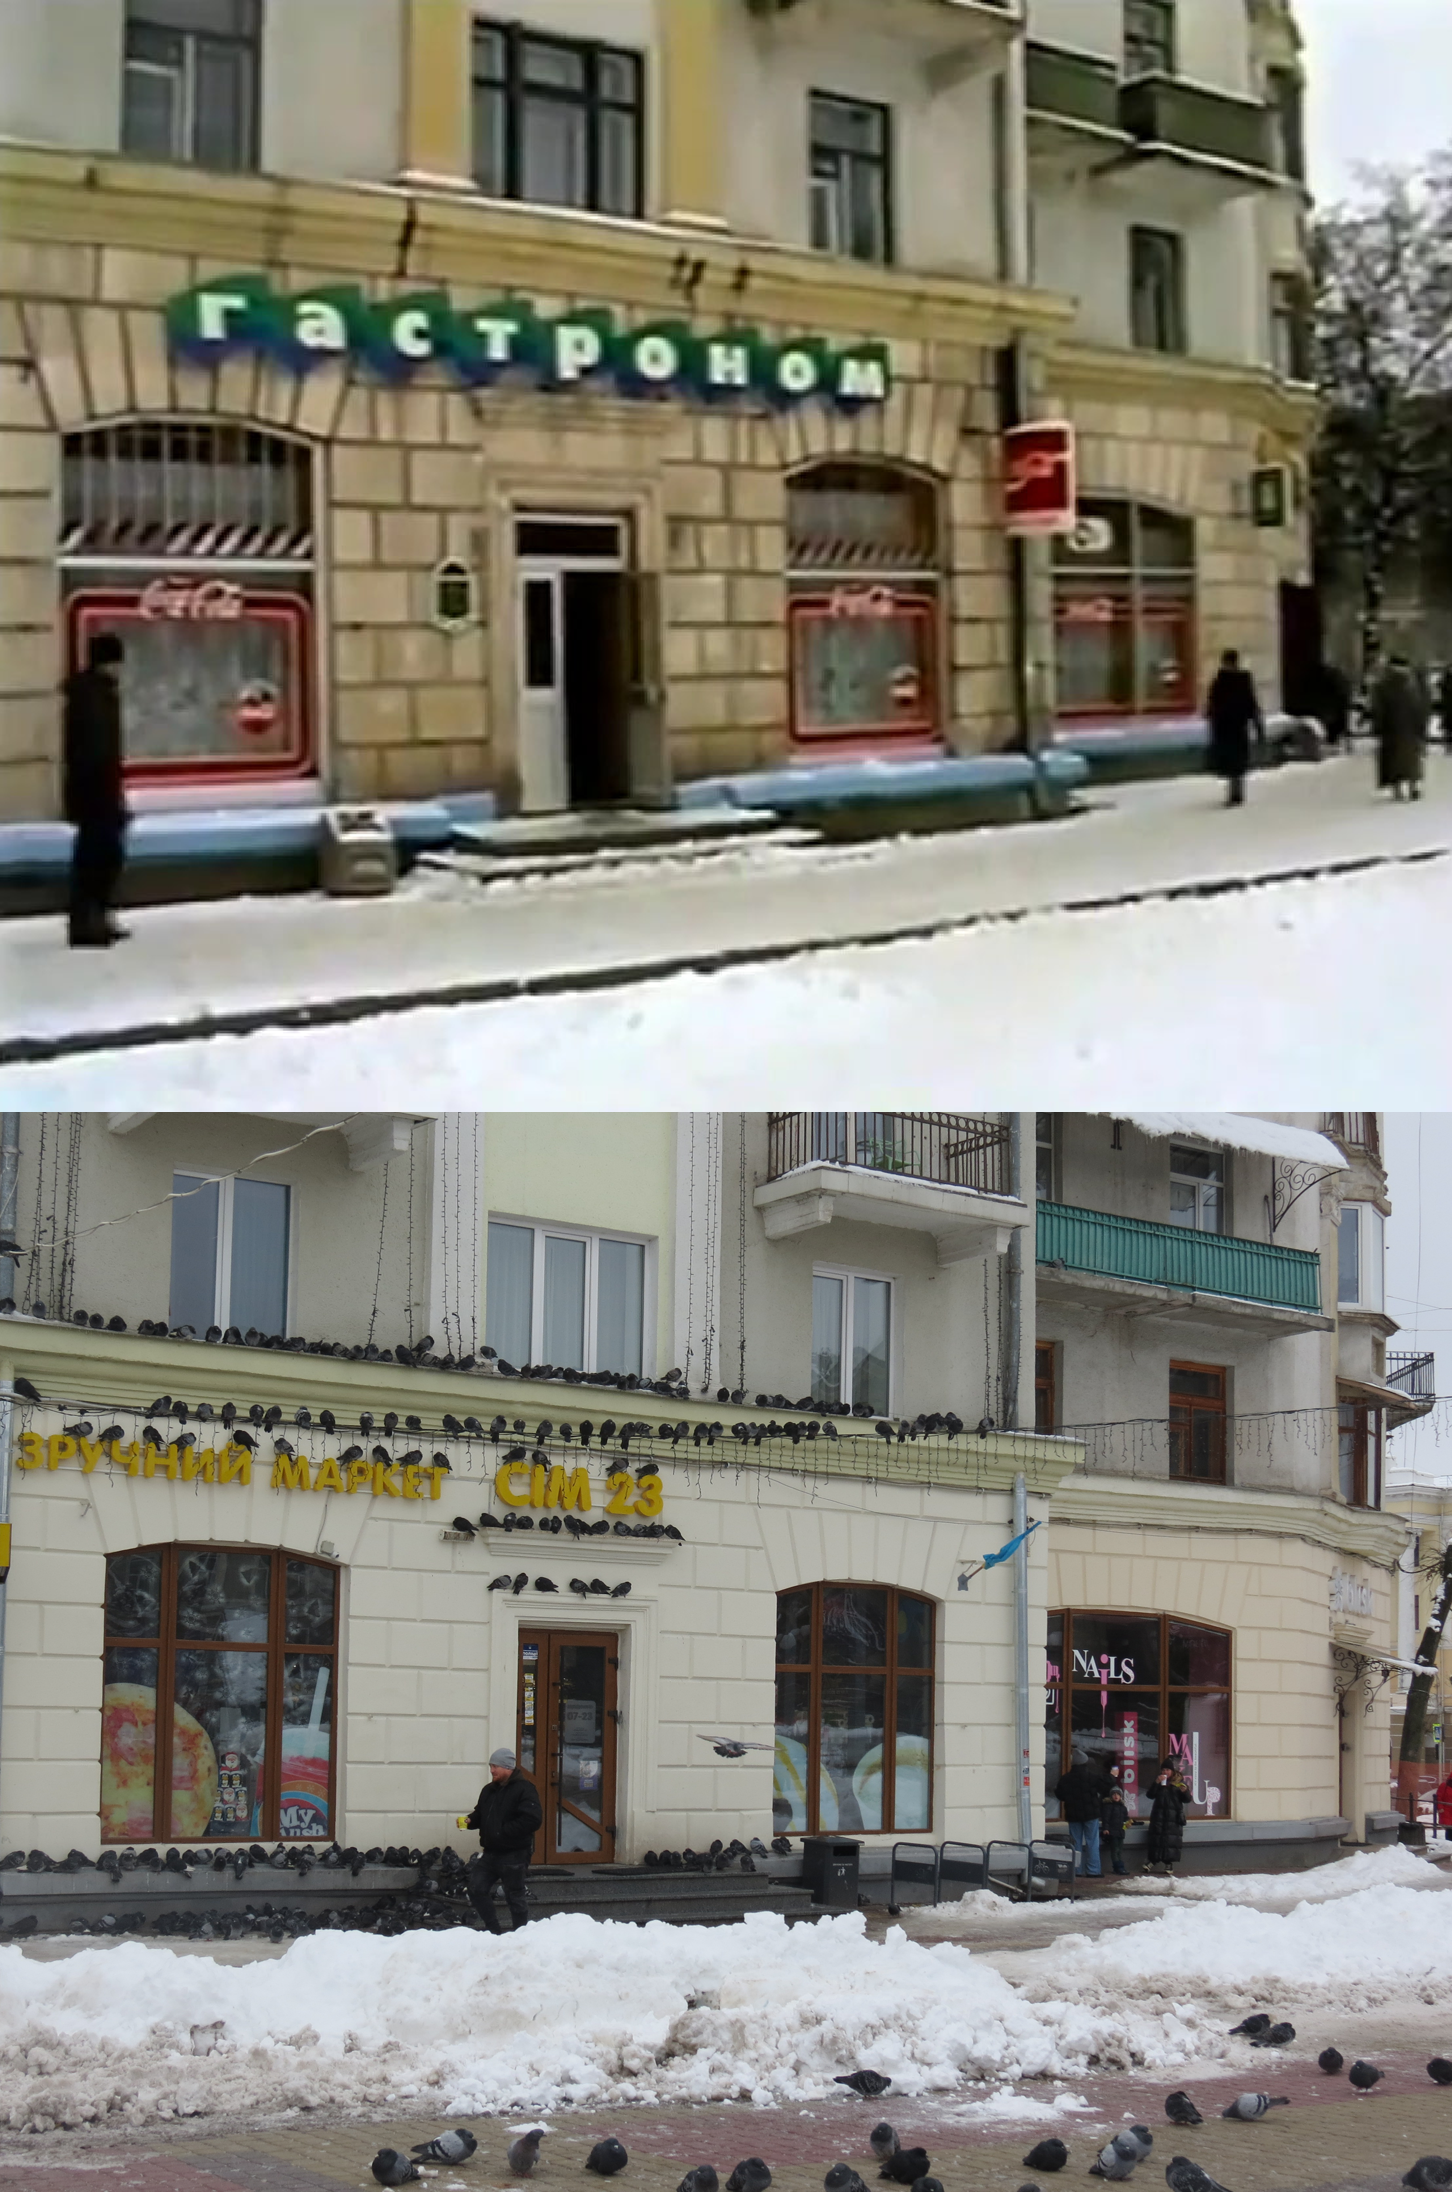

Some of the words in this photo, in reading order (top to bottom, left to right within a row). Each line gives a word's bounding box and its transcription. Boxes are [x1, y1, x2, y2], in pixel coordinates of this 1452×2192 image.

[16, 1432, 252, 1485] ЗРУЧНИЙ
[270, 1454, 449, 1500] МАРКЕТ
[495, 1462, 592, 1511] СІМ
[605, 1472, 664, 1517] 23
[280, 1805, 316, 1828] My
